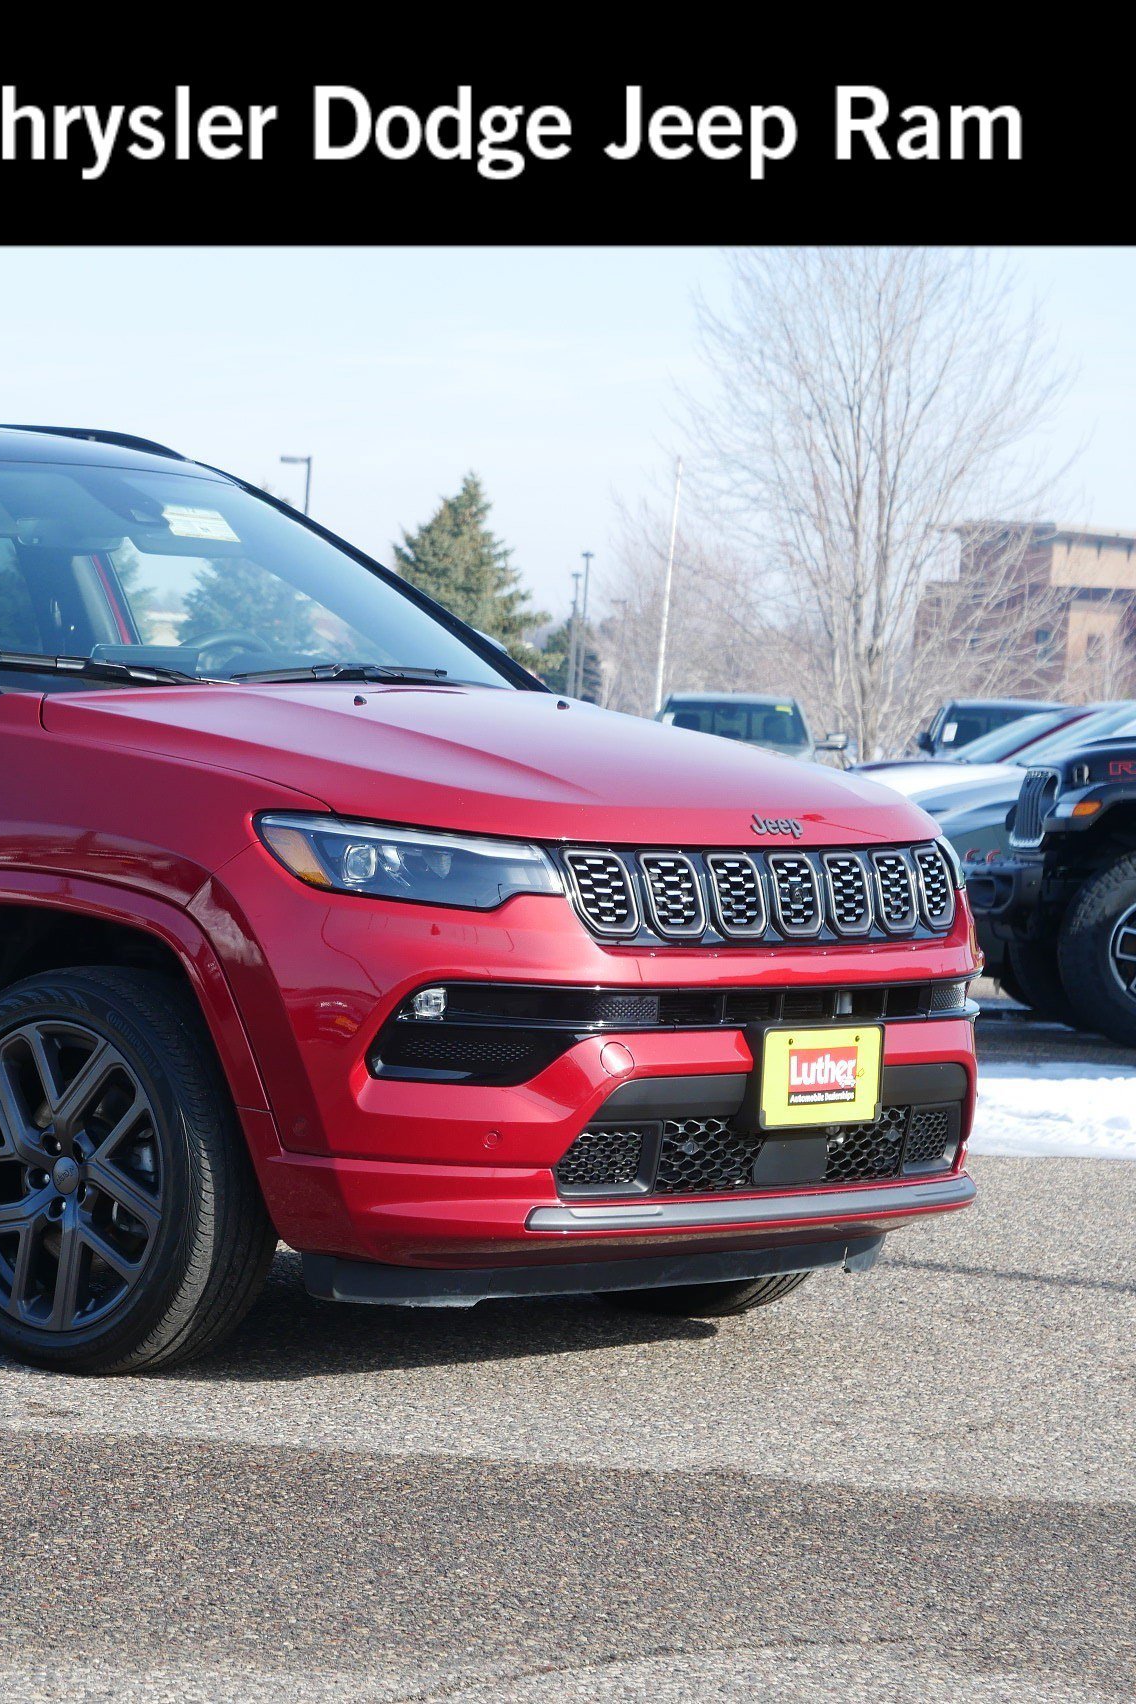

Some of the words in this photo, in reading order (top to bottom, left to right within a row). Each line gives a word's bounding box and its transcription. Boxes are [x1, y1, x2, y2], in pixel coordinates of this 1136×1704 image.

[751, 813, 804, 839] Jeep
[790, 1054, 856, 1086] Luther
[790, 1093, 824, 1103] Automobile
